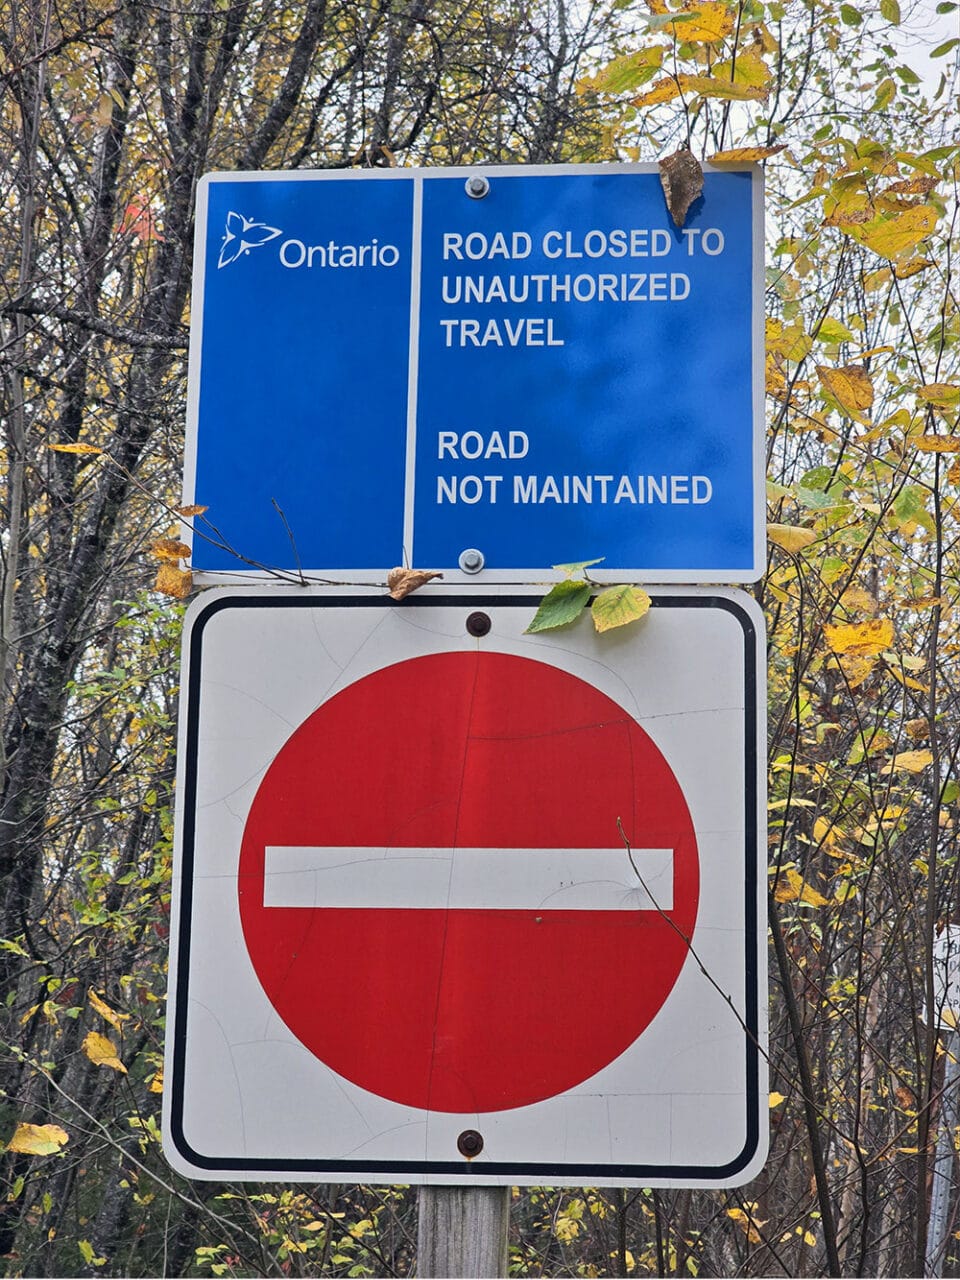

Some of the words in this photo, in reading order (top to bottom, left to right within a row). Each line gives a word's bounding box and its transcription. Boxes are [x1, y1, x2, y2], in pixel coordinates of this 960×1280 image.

[279, 238, 400, 269] Ontario
[442, 231, 532, 261] ROAD
[542, 228, 672, 259] CLOSED
[681, 227, 725, 257] TO
[441, 272, 691, 304] UNAUTHORIZED
[440, 318, 565, 347] TRAVEL
[438, 430, 529, 460] ROAD
[436, 475, 504, 505] NOT
[513, 475, 713, 505] MAINTAINED
